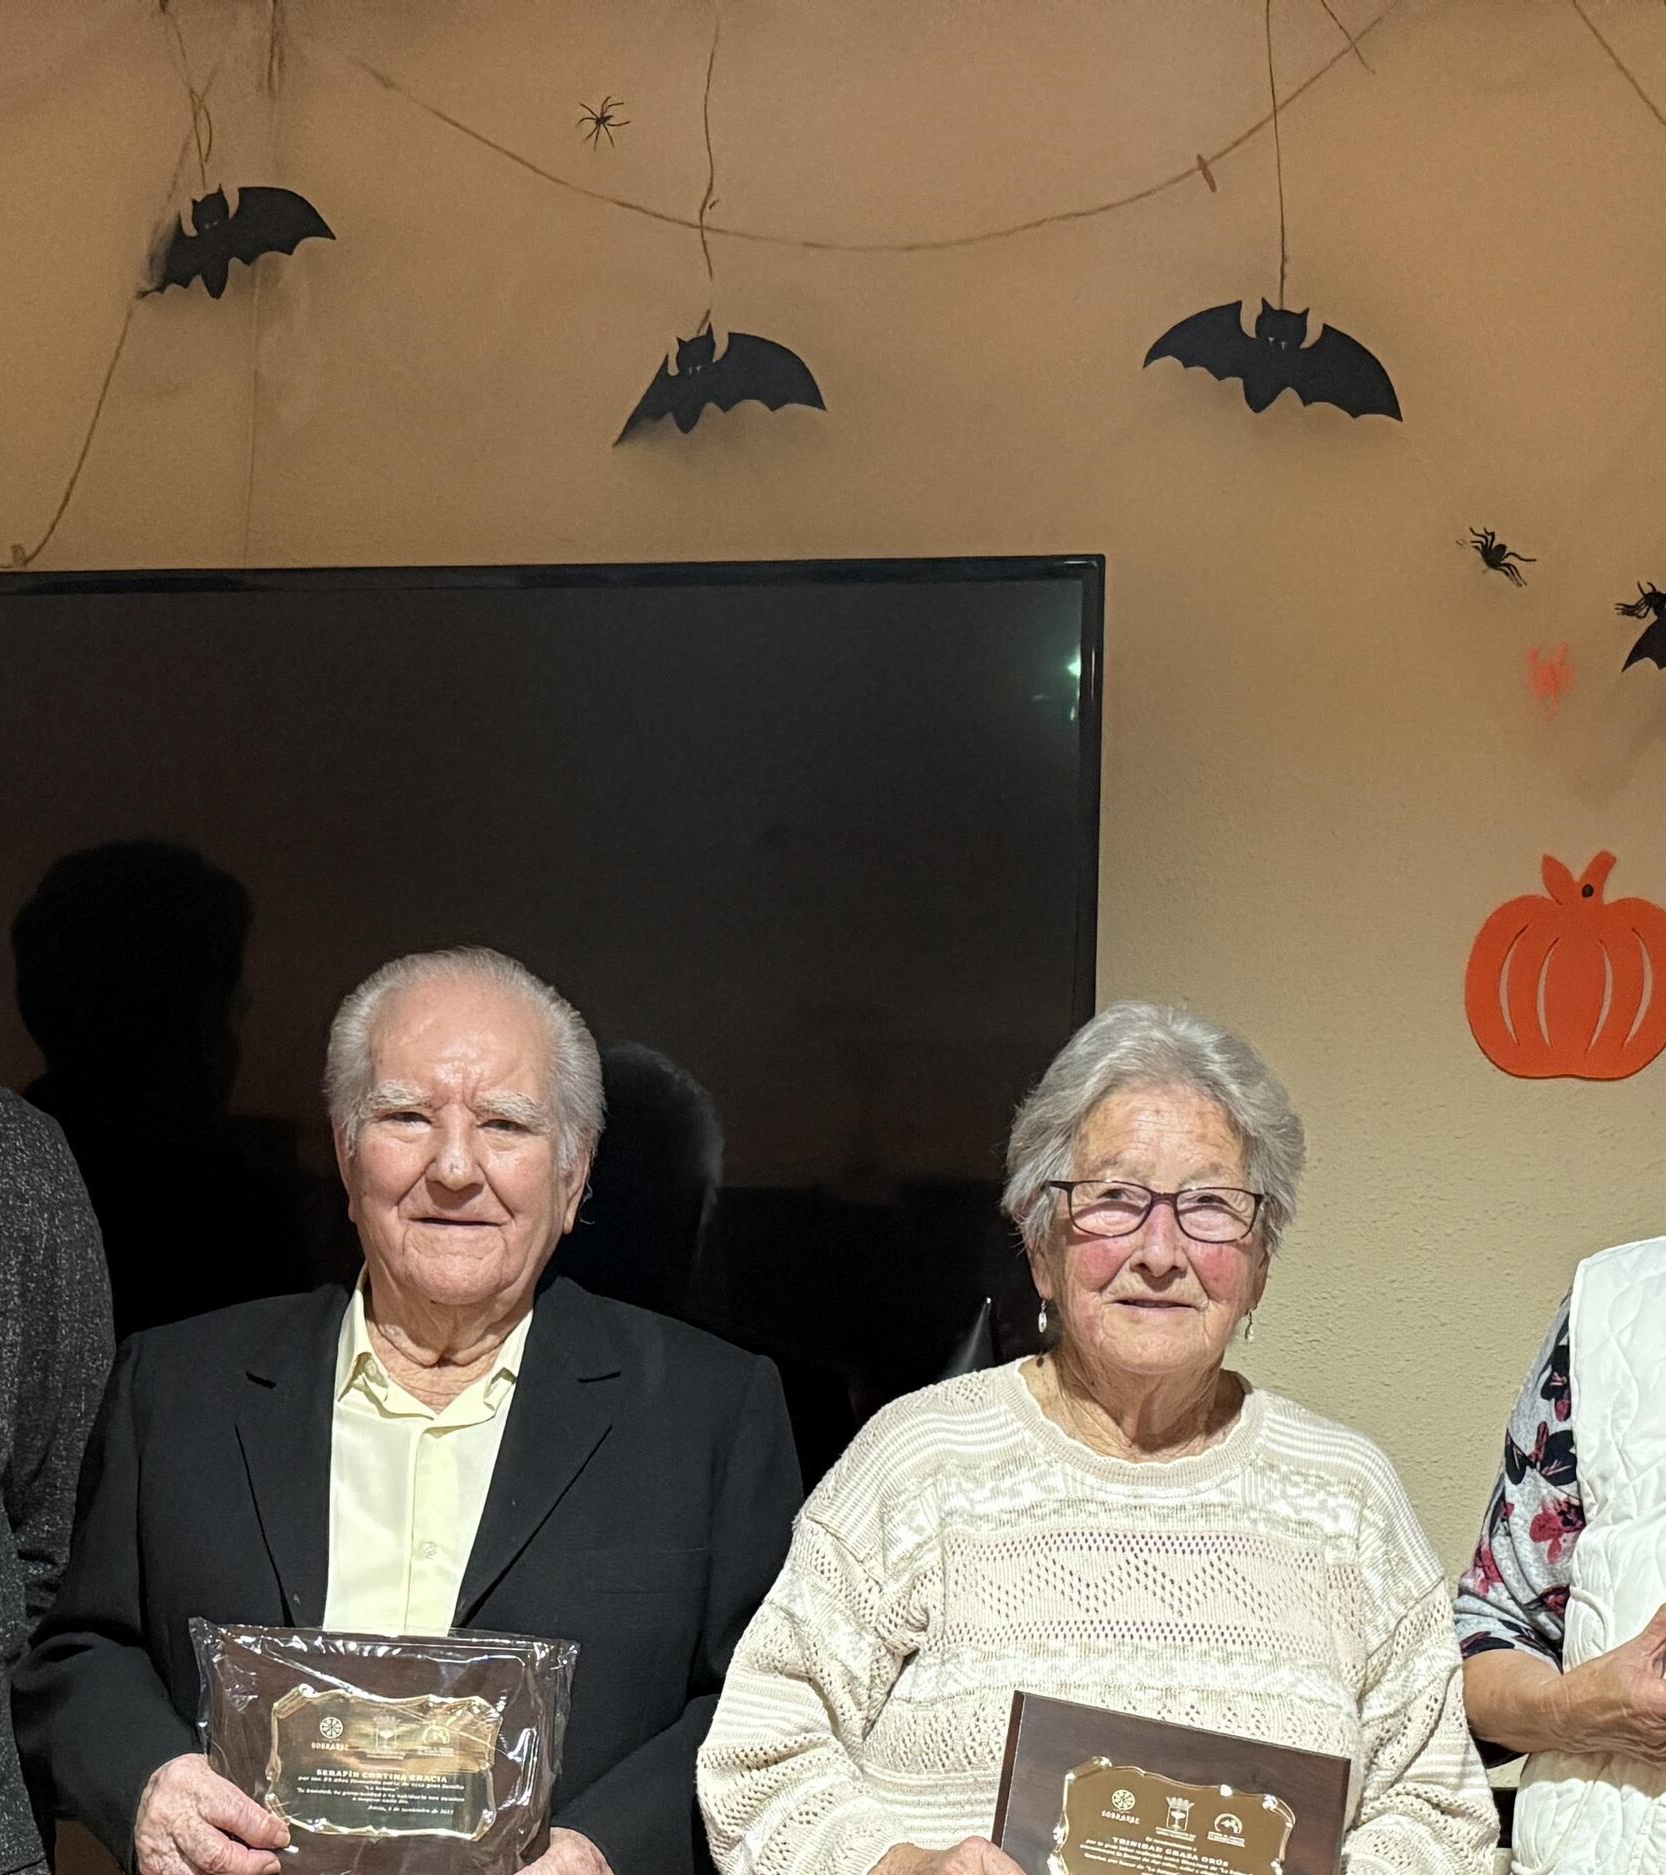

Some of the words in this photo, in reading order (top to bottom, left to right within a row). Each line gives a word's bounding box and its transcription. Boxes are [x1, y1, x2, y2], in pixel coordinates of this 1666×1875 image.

[363, 1771, 407, 1782] CORTINA
[408, 1773, 447, 1783] GRACIA
[1112, 1836, 1163, 1852] TRINIDAD
